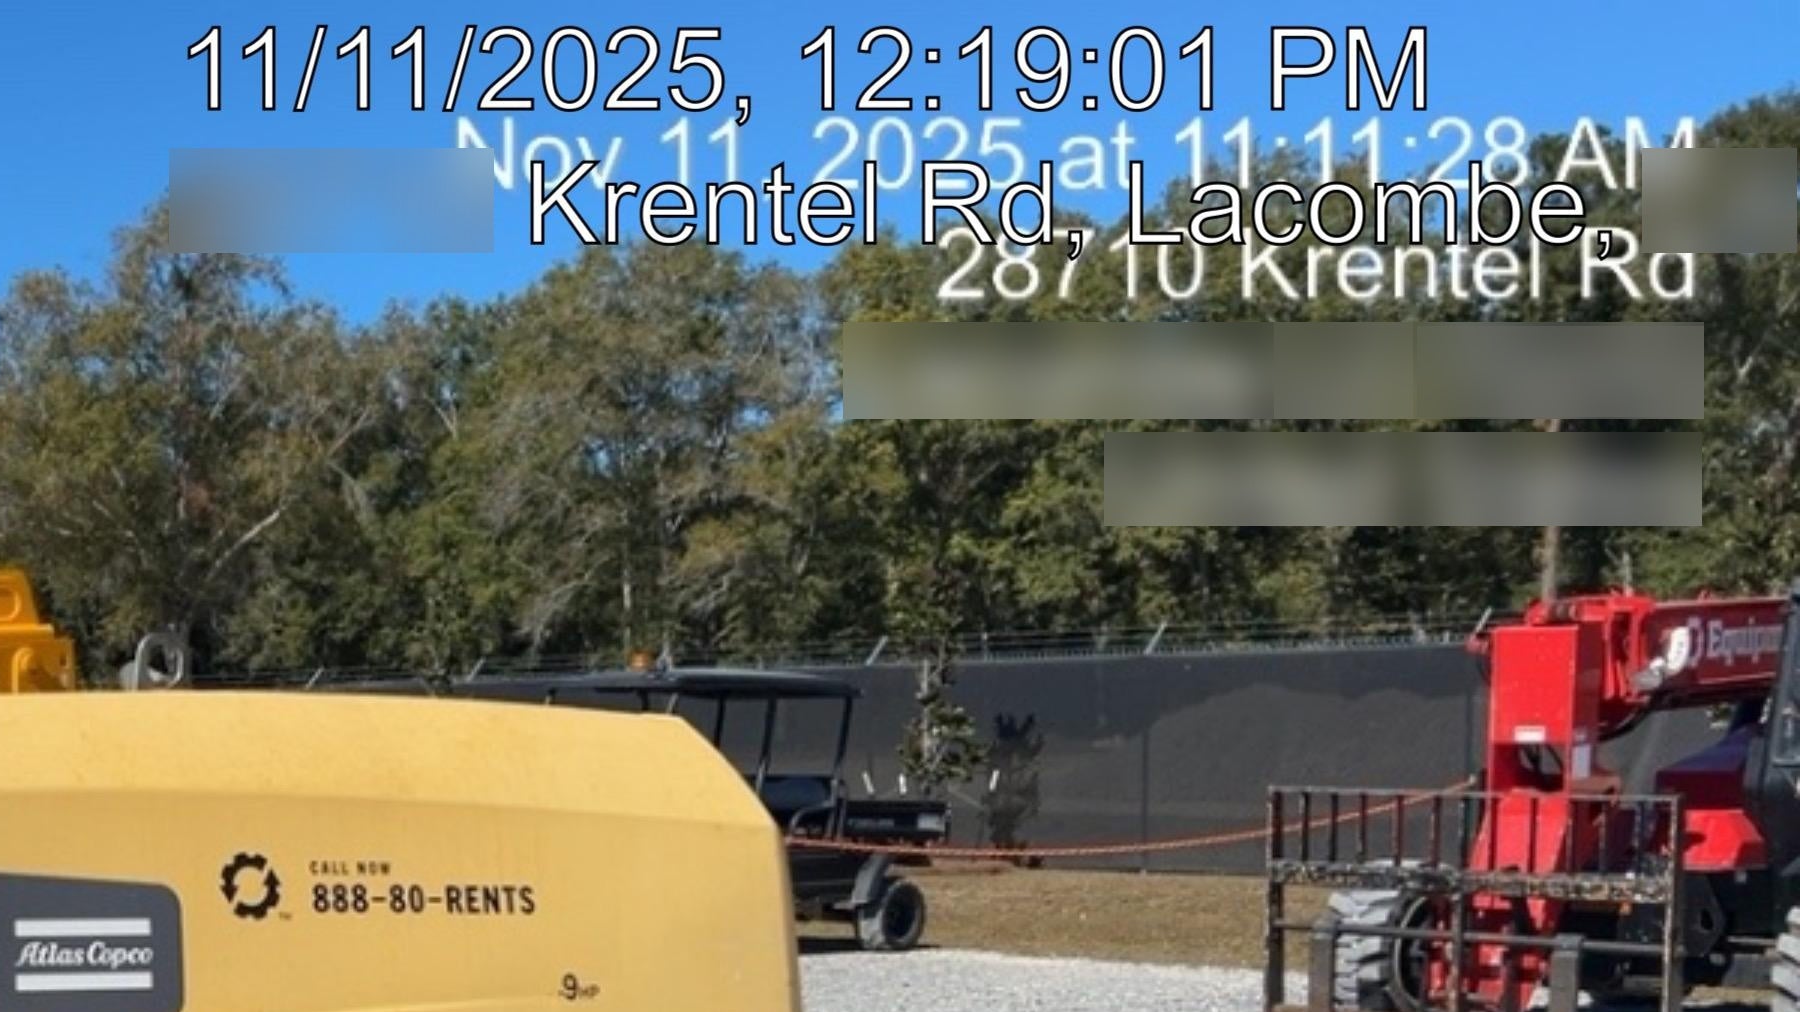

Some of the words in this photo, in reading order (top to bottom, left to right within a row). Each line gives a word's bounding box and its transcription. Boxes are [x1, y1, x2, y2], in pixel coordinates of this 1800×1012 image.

[309, 860, 349, 876] CALL
[357, 860, 391, 876] NOW
[312, 883, 536, 916] 888-80-RENTS
[15, 940, 84, 969] Atlas
[85, 940, 154, 970] Copco
